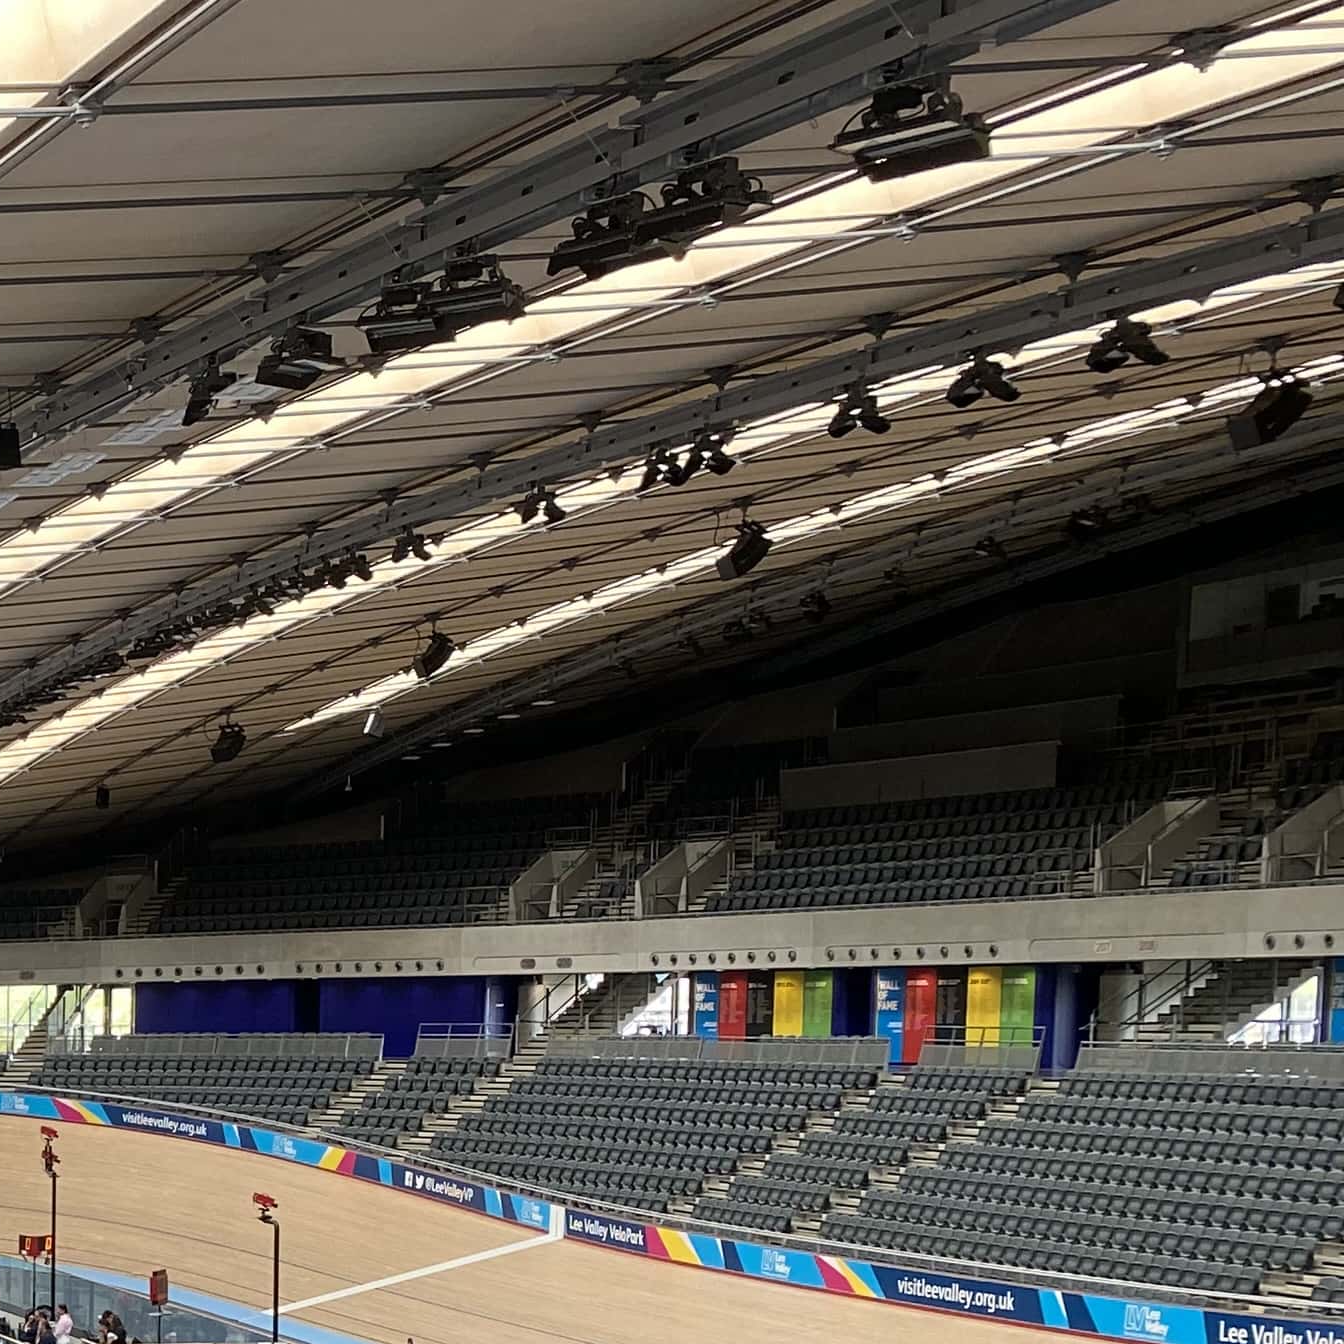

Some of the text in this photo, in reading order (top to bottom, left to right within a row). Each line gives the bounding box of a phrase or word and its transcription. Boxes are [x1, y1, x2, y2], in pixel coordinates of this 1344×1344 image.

[122, 1110, 208, 1137] visitleevalley.org.uk
[569, 1214, 645, 1246] Lee Valley VeloPark
[898, 1277, 1015, 1313] visitleevalley.org.uk
[1219, 1321, 1249, 1344] Lee
